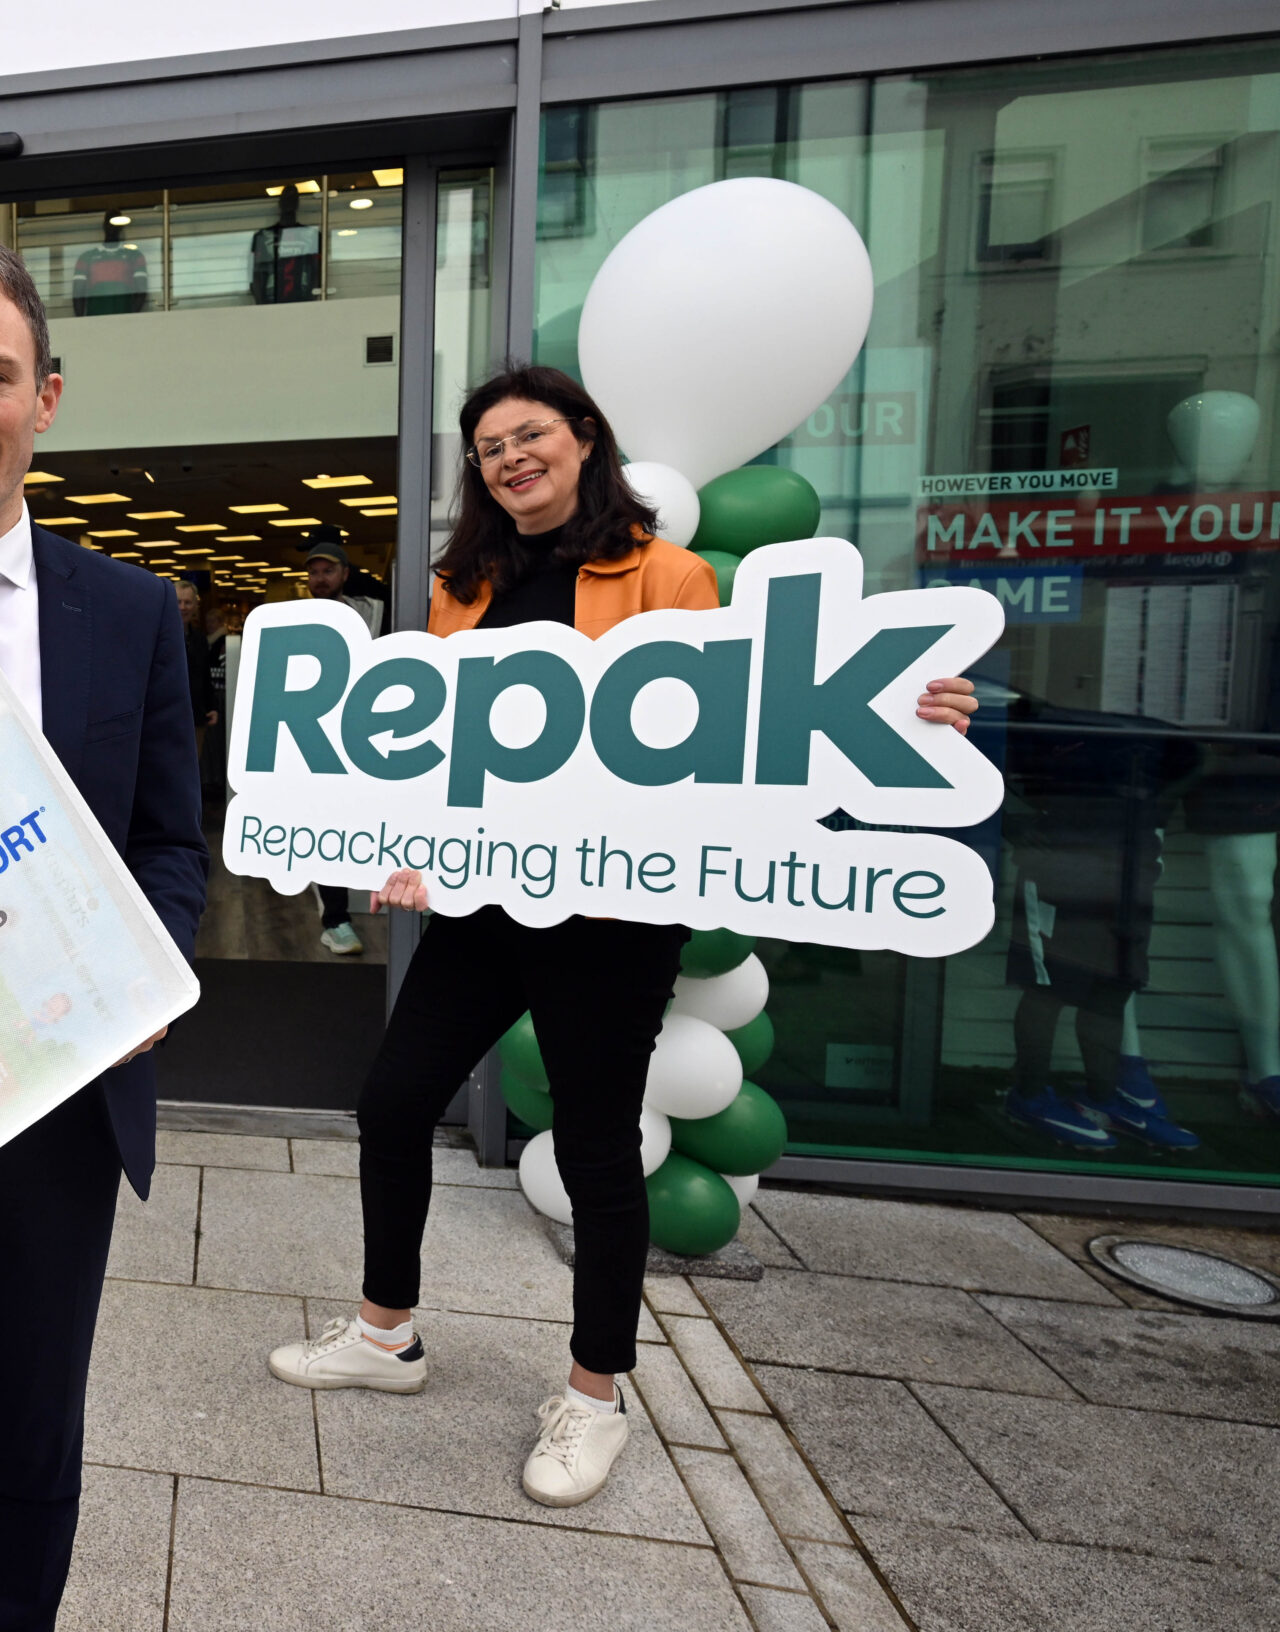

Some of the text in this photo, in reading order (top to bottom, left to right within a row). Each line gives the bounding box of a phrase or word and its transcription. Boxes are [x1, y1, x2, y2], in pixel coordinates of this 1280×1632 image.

[786, 401, 904, 438] OUR
[921, 471, 1114, 493] HOWEVER YOU MOVE
[926, 508, 1076, 551] MAKE
[1093, 507, 1142, 546] IT
[926, 575, 1073, 614] ME
[245, 572, 956, 809] Repak
[240, 815, 947, 919] Repackaging the Future
